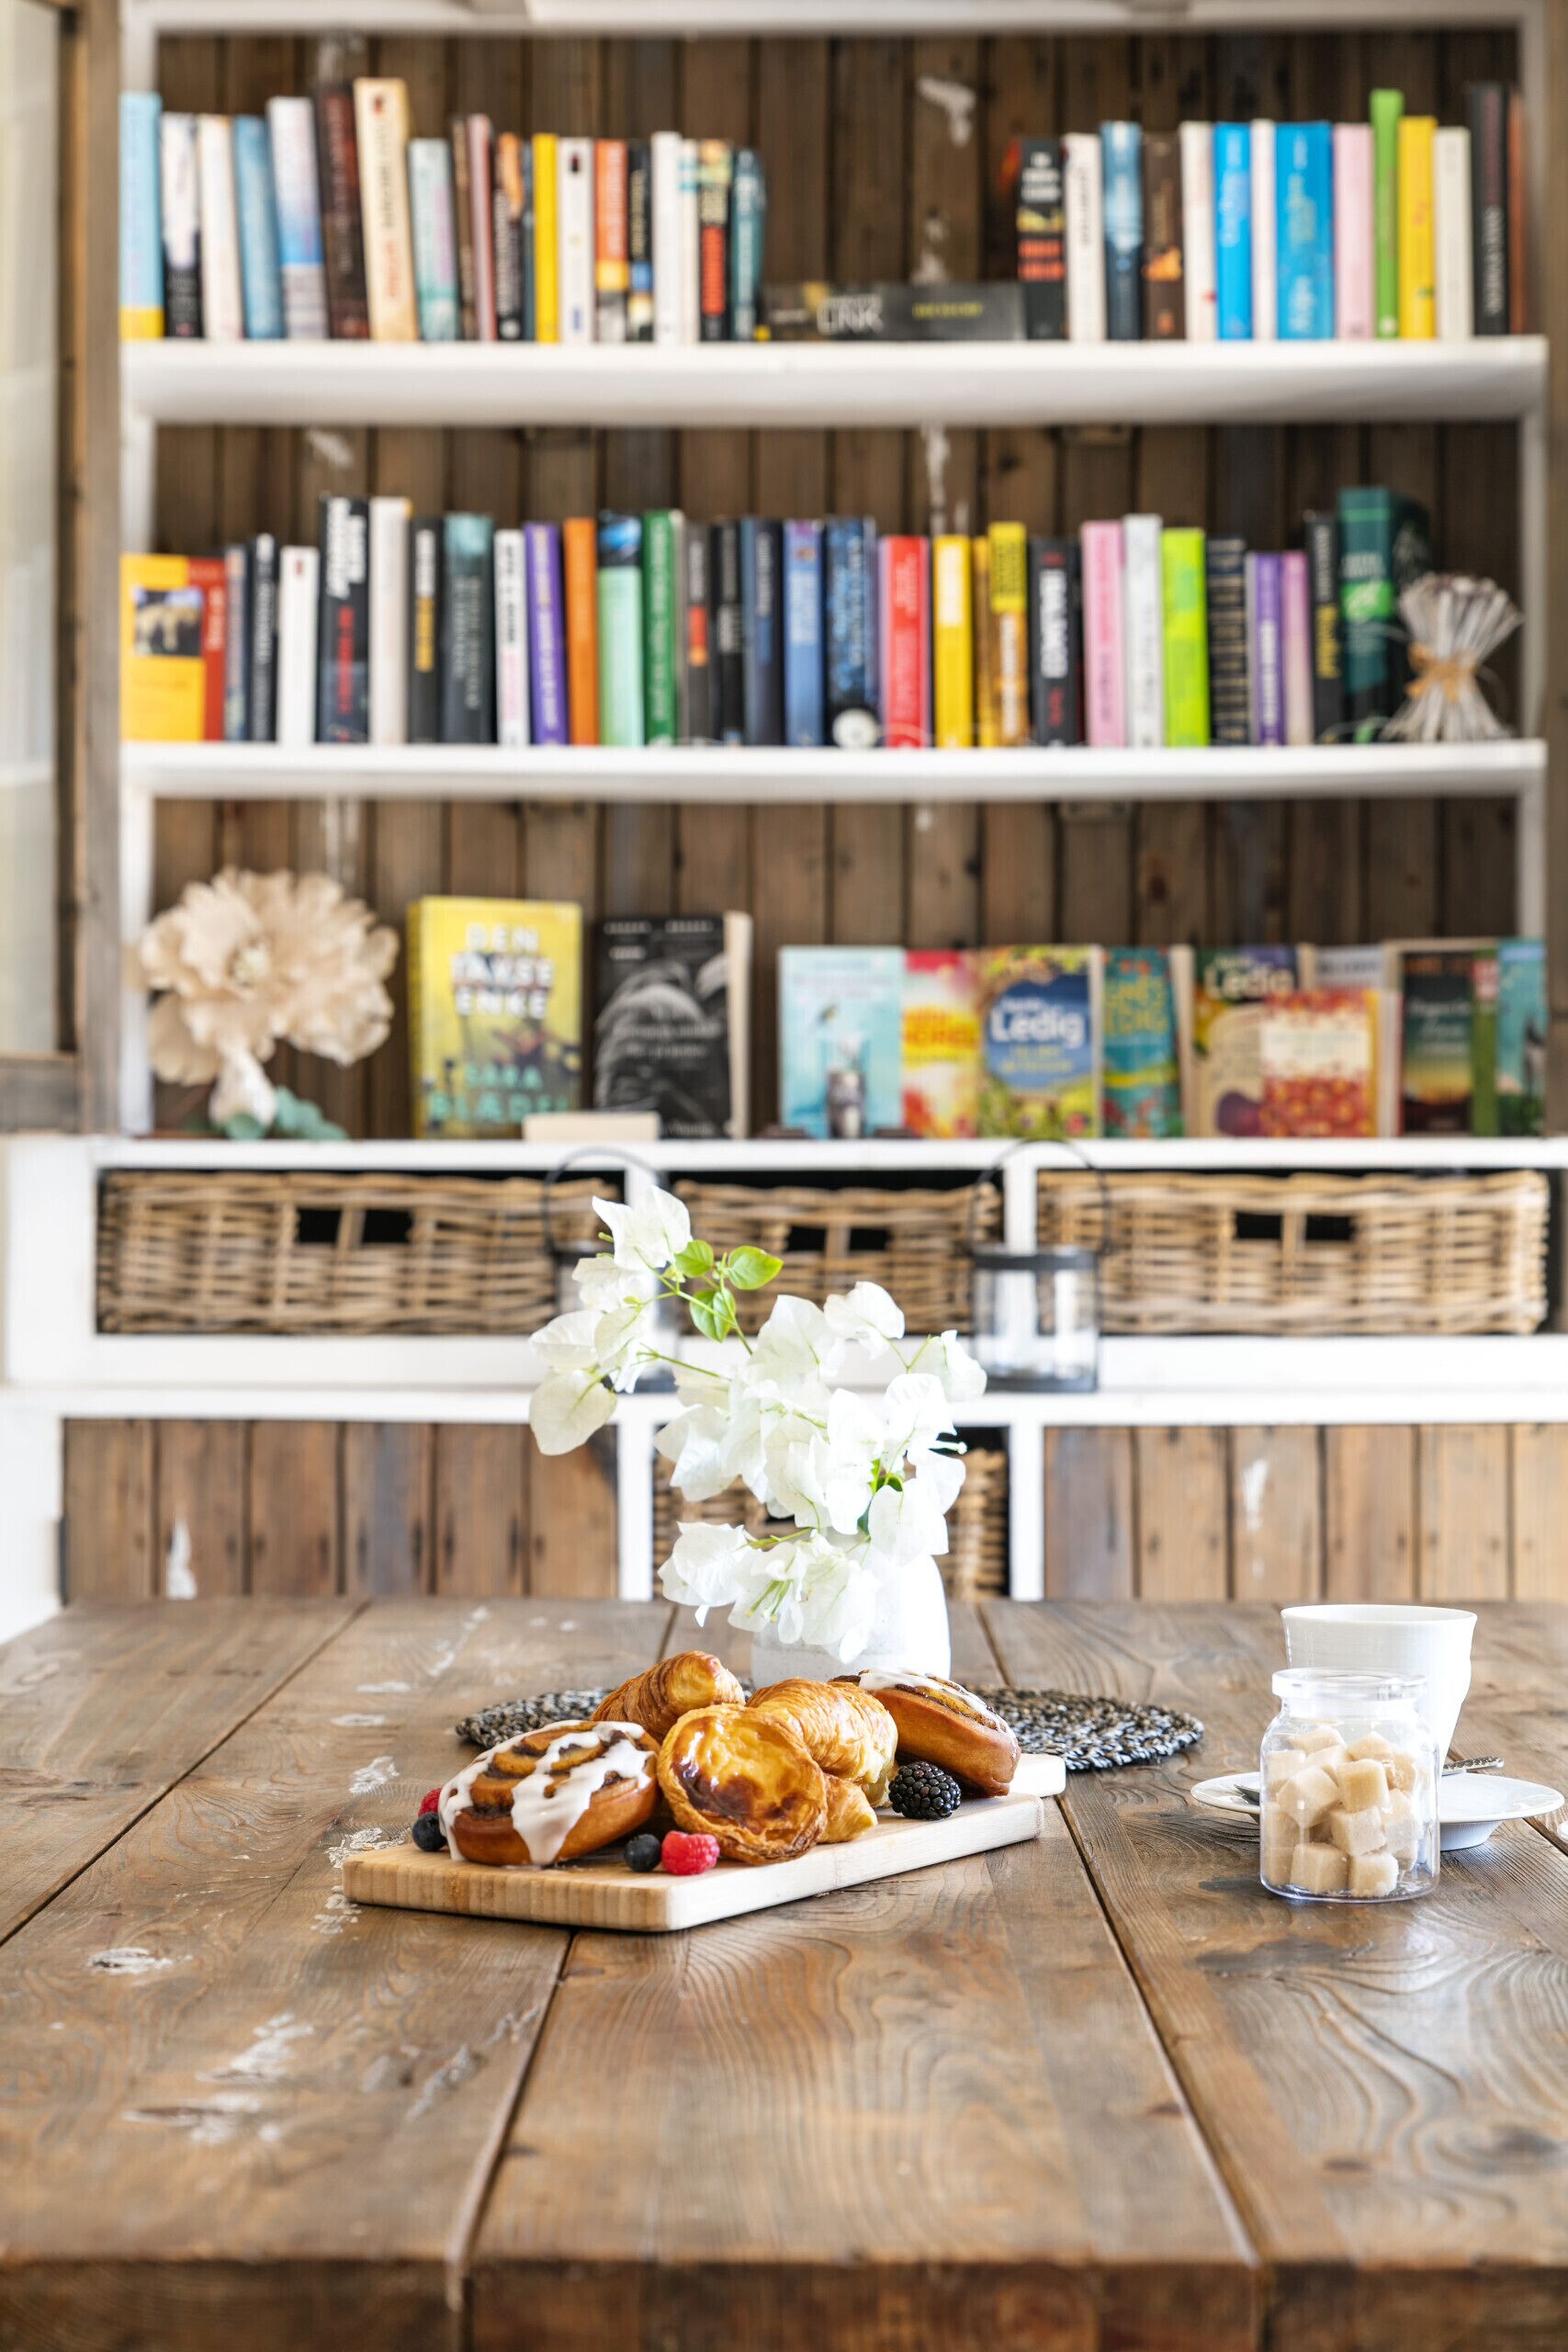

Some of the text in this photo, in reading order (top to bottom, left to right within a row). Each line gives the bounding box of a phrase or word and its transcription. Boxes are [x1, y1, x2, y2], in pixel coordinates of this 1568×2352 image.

[467, 923, 538, 954] DEN
[456, 989, 548, 1019] ENKE
[991, 1006, 1085, 1048] Ledig
